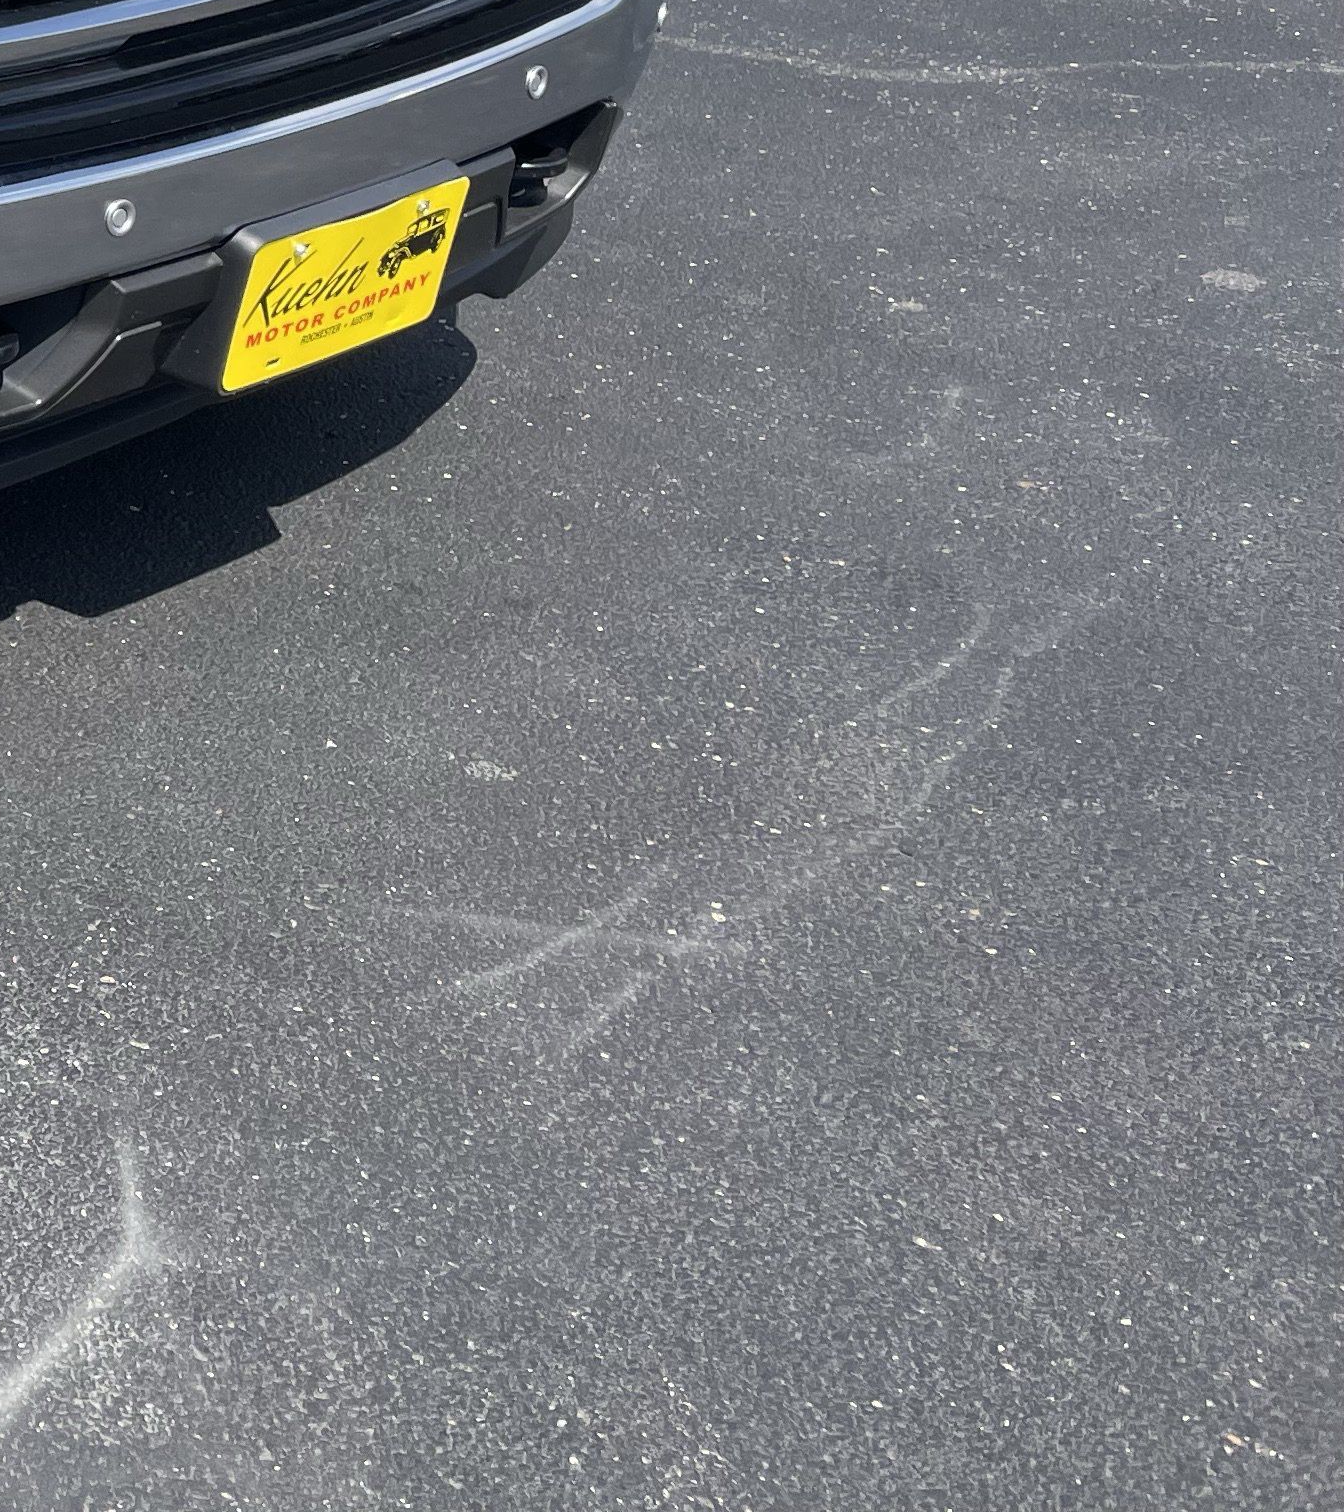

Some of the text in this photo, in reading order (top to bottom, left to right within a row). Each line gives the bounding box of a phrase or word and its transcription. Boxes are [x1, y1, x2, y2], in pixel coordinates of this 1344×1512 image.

[242, 237, 370, 328] Kuehn
[245, 270, 432, 349] MOTOR COMPANY
